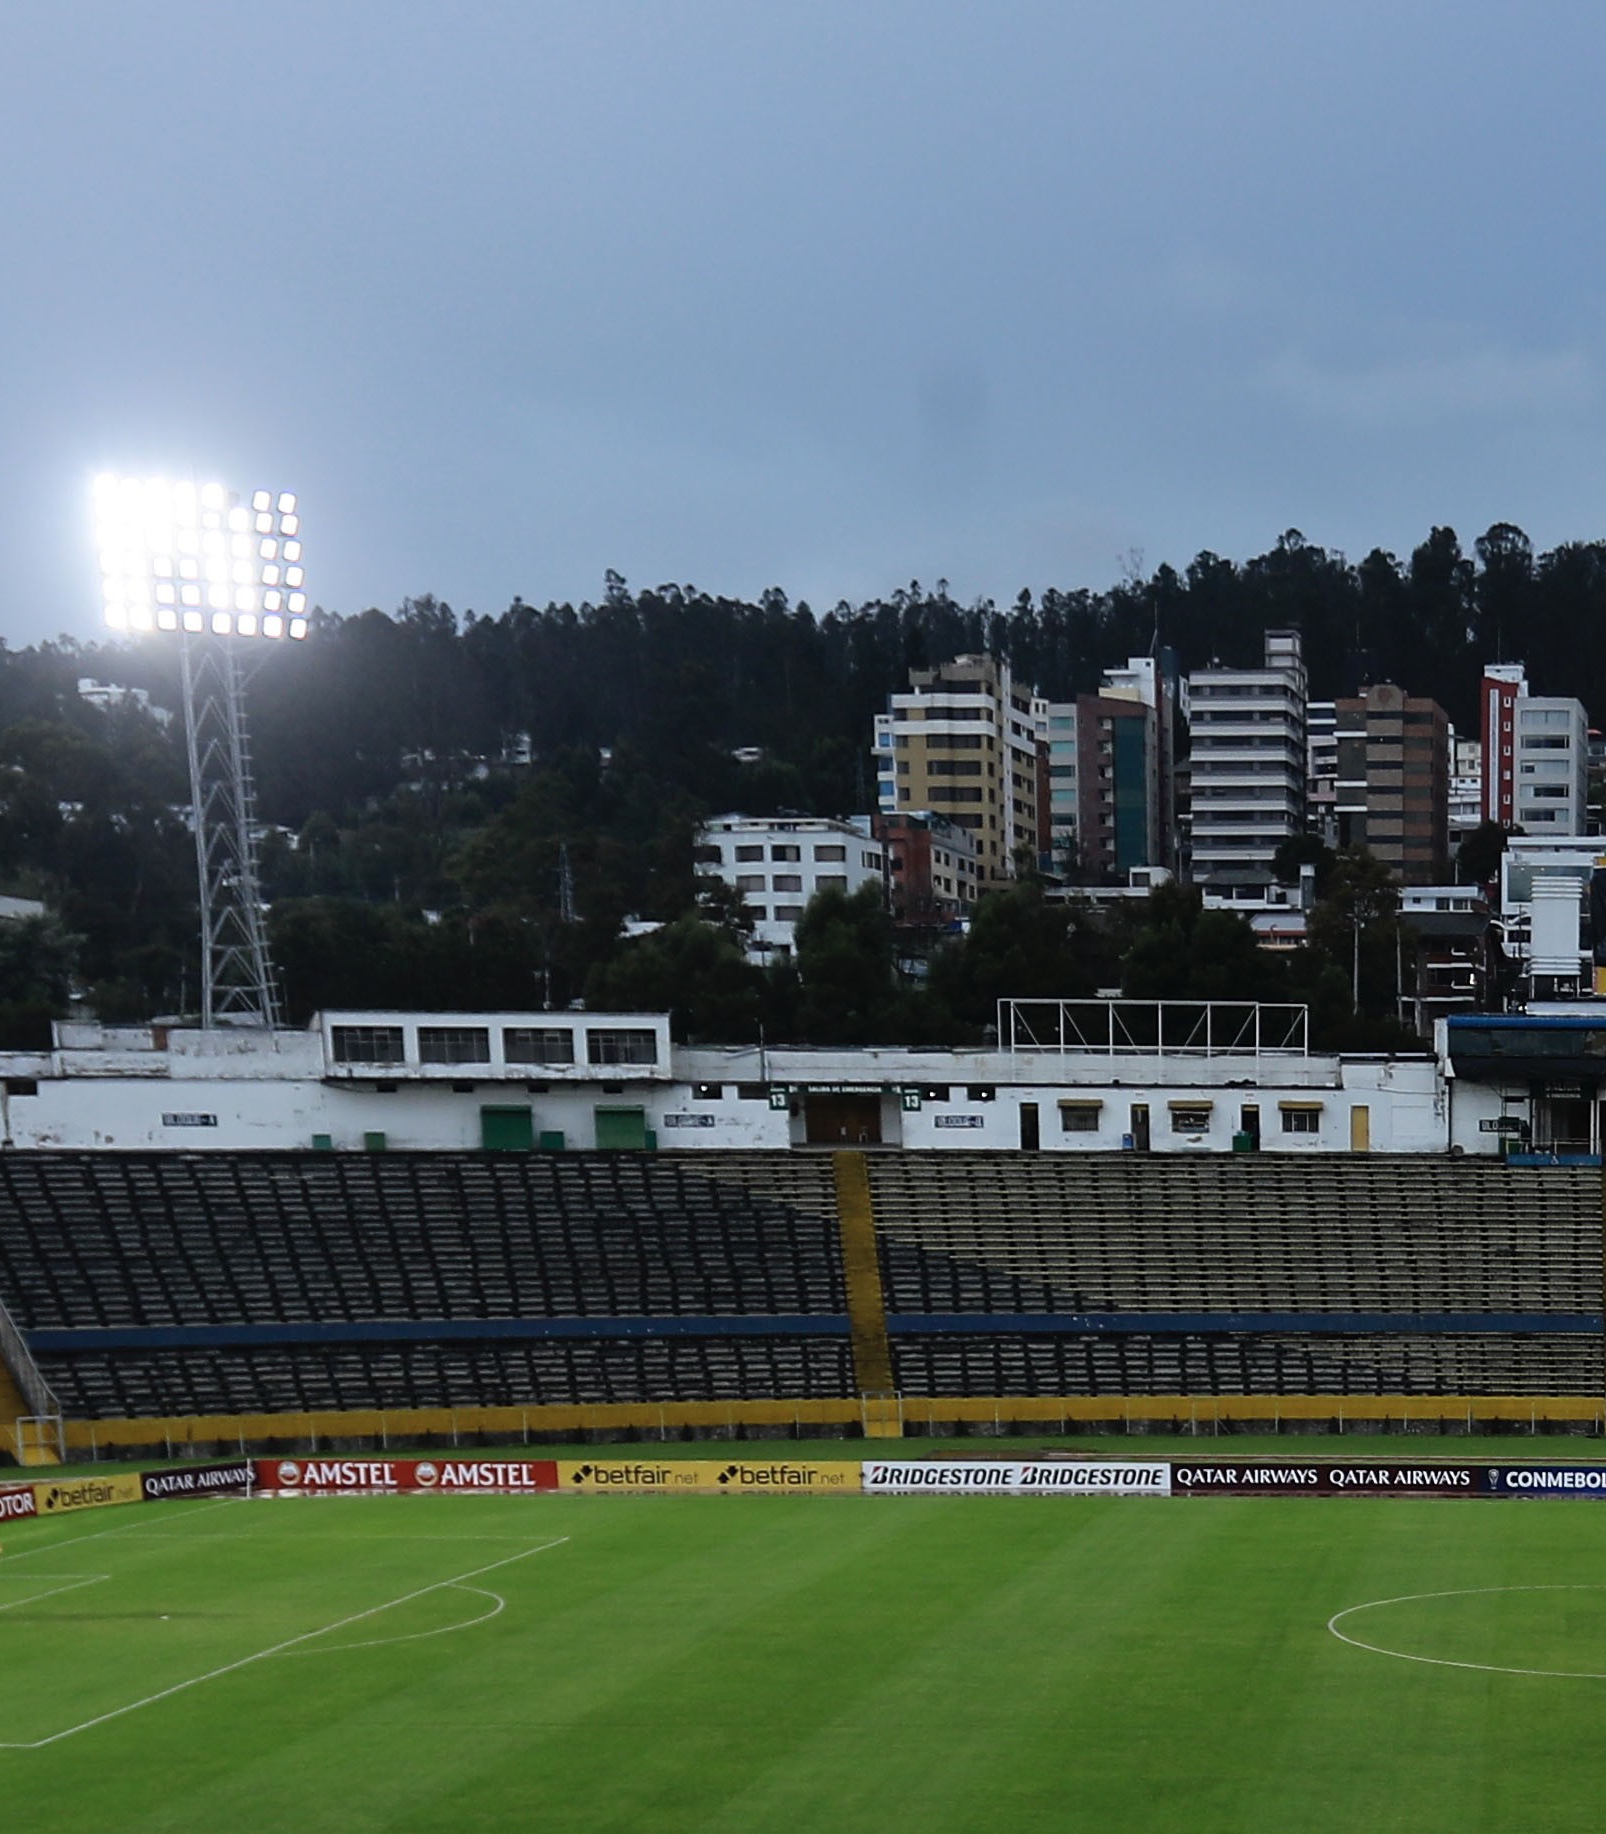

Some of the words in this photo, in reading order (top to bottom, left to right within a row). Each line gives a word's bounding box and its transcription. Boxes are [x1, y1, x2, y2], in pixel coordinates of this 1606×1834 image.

[771, 1094, 786, 1107] 13
[904, 1095, 919, 1108] 13
[145, 1471, 195, 1496] QATAR
[197, 1466, 256, 1491] AIRWAYS
[303, 1462, 396, 1486] AMSTEL
[441, 1463, 535, 1487] AMSTEL
[595, 1464, 698, 1486] betfair.net
[740, 1464, 845, 1487] betfair.net
[869, 1465, 1014, 1487] BRIDGESTONE
[1020, 1465, 1163, 1487] BRIDGESTONE
[1177, 1467, 1236, 1486] QATAR
[1240, 1467, 1318, 1486] AIRWAYS
[1329, 1468, 1389, 1487] QATAR
[1393, 1469, 1471, 1487] AIRWAYS
